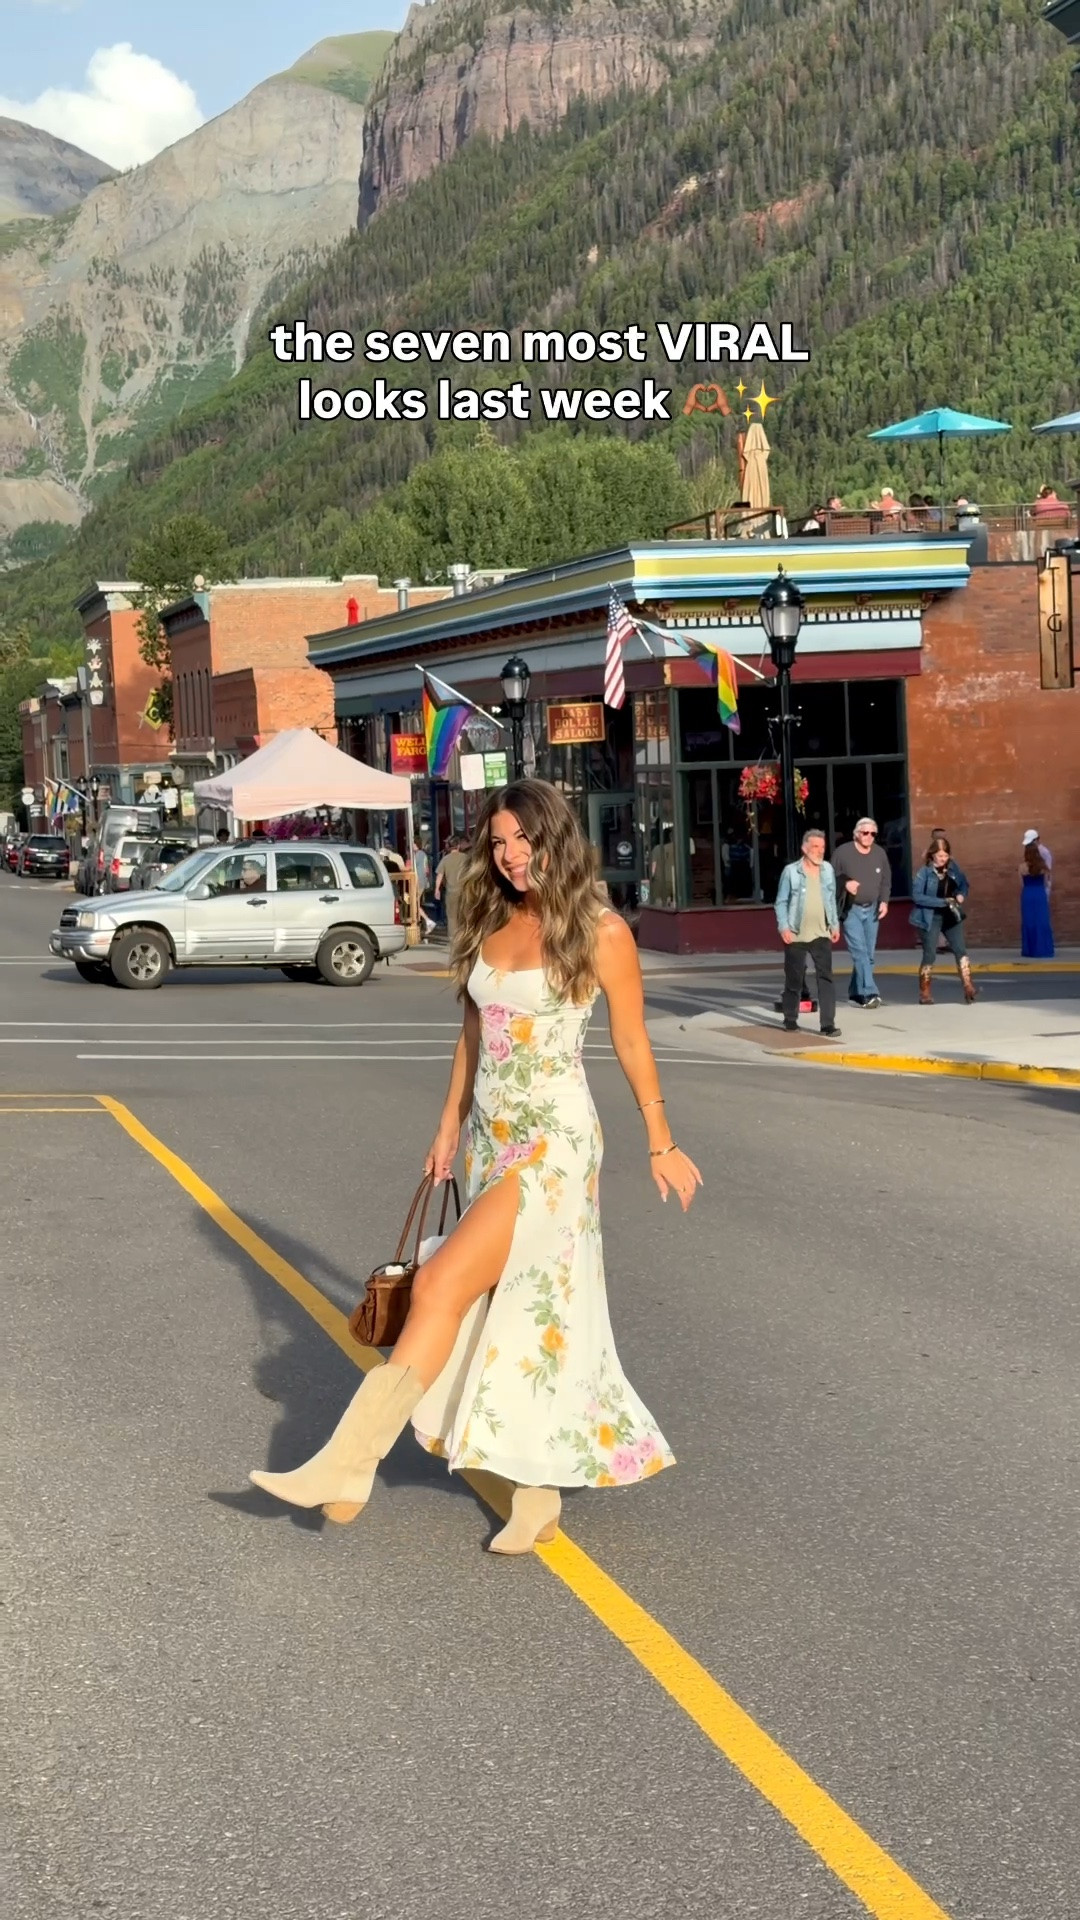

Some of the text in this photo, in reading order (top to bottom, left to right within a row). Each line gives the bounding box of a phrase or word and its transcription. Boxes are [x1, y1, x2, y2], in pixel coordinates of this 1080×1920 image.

[561, 707, 590, 718] LAST
[555, 727, 600, 739] SALOON
[396, 746, 427, 757] FARG
